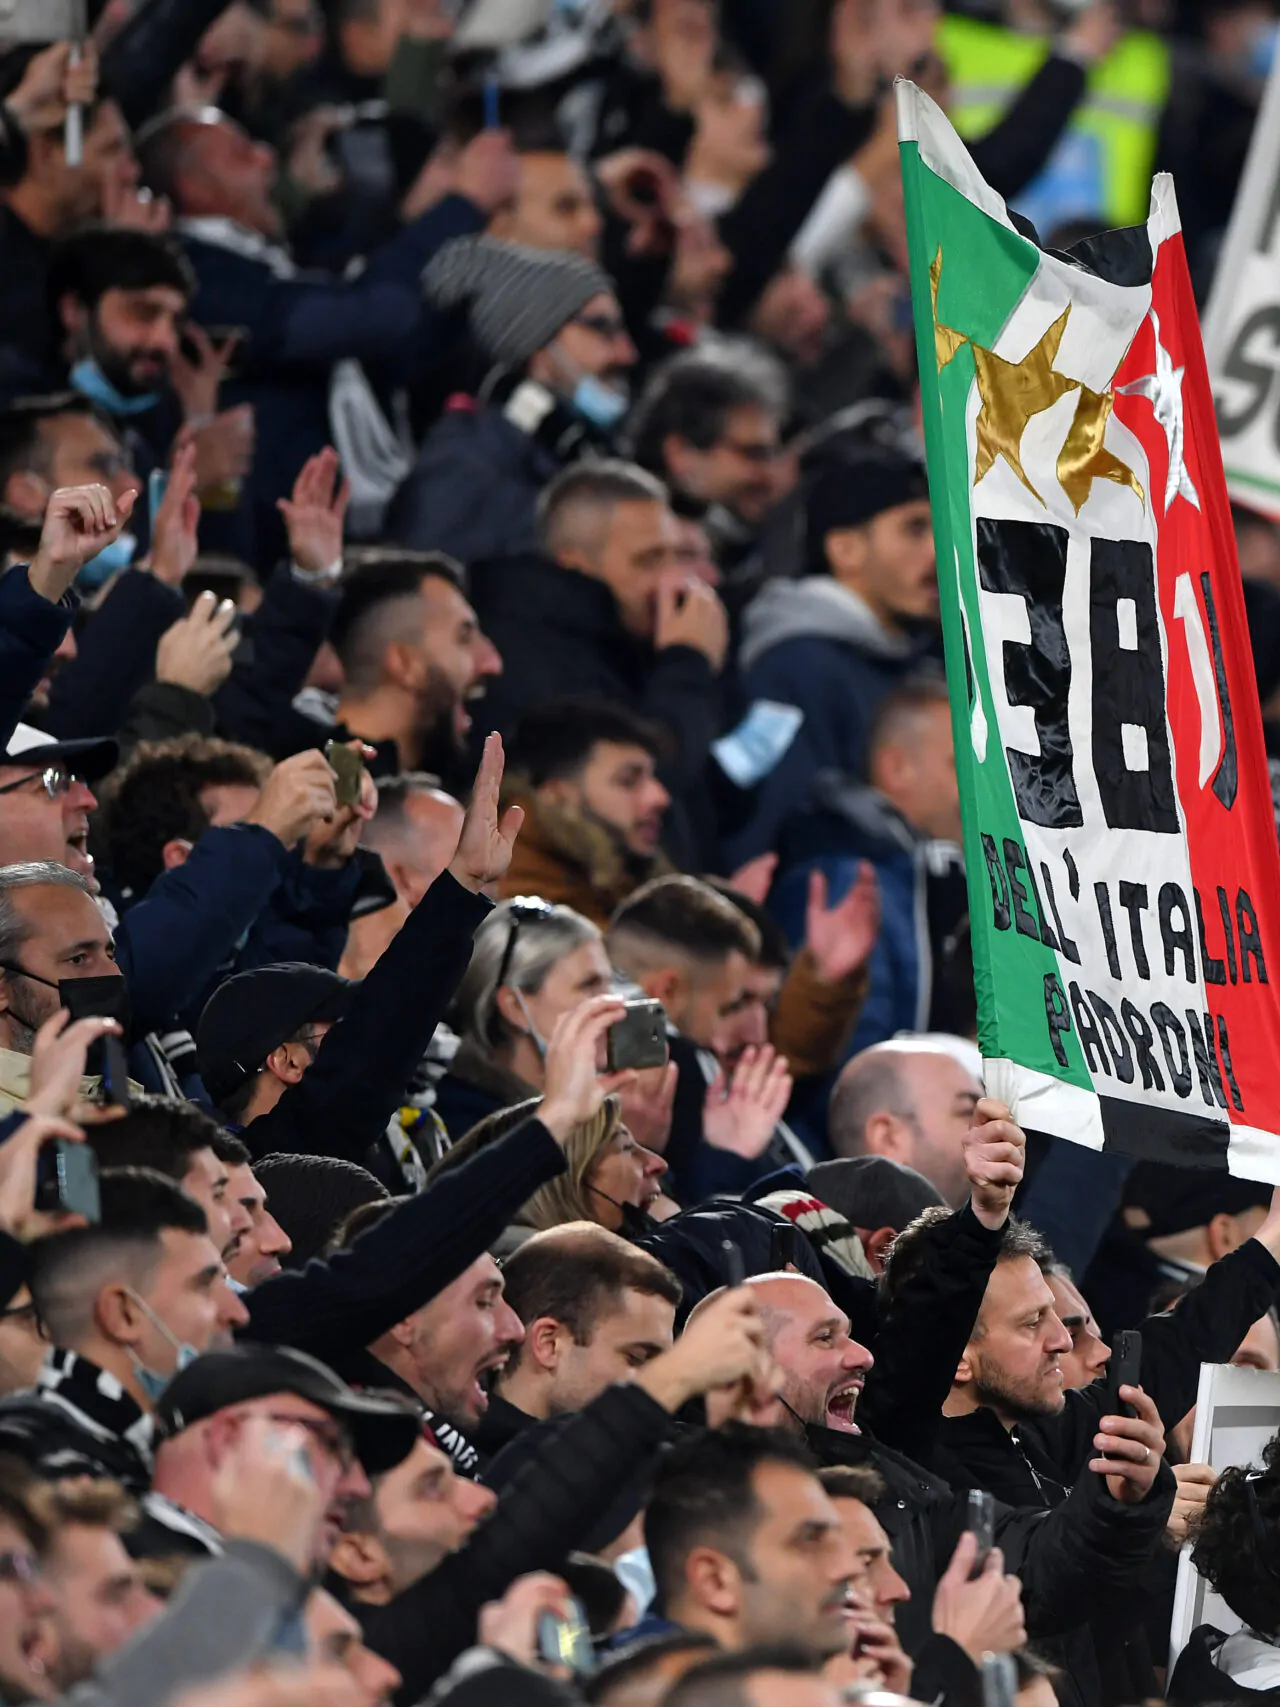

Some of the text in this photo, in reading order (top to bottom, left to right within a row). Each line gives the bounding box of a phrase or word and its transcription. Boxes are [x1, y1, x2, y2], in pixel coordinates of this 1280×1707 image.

[976, 517, 1181, 833] 38
[980, 832, 1269, 985] DELL'ITALIA
[1043, 972, 1245, 1112] PADRONI
